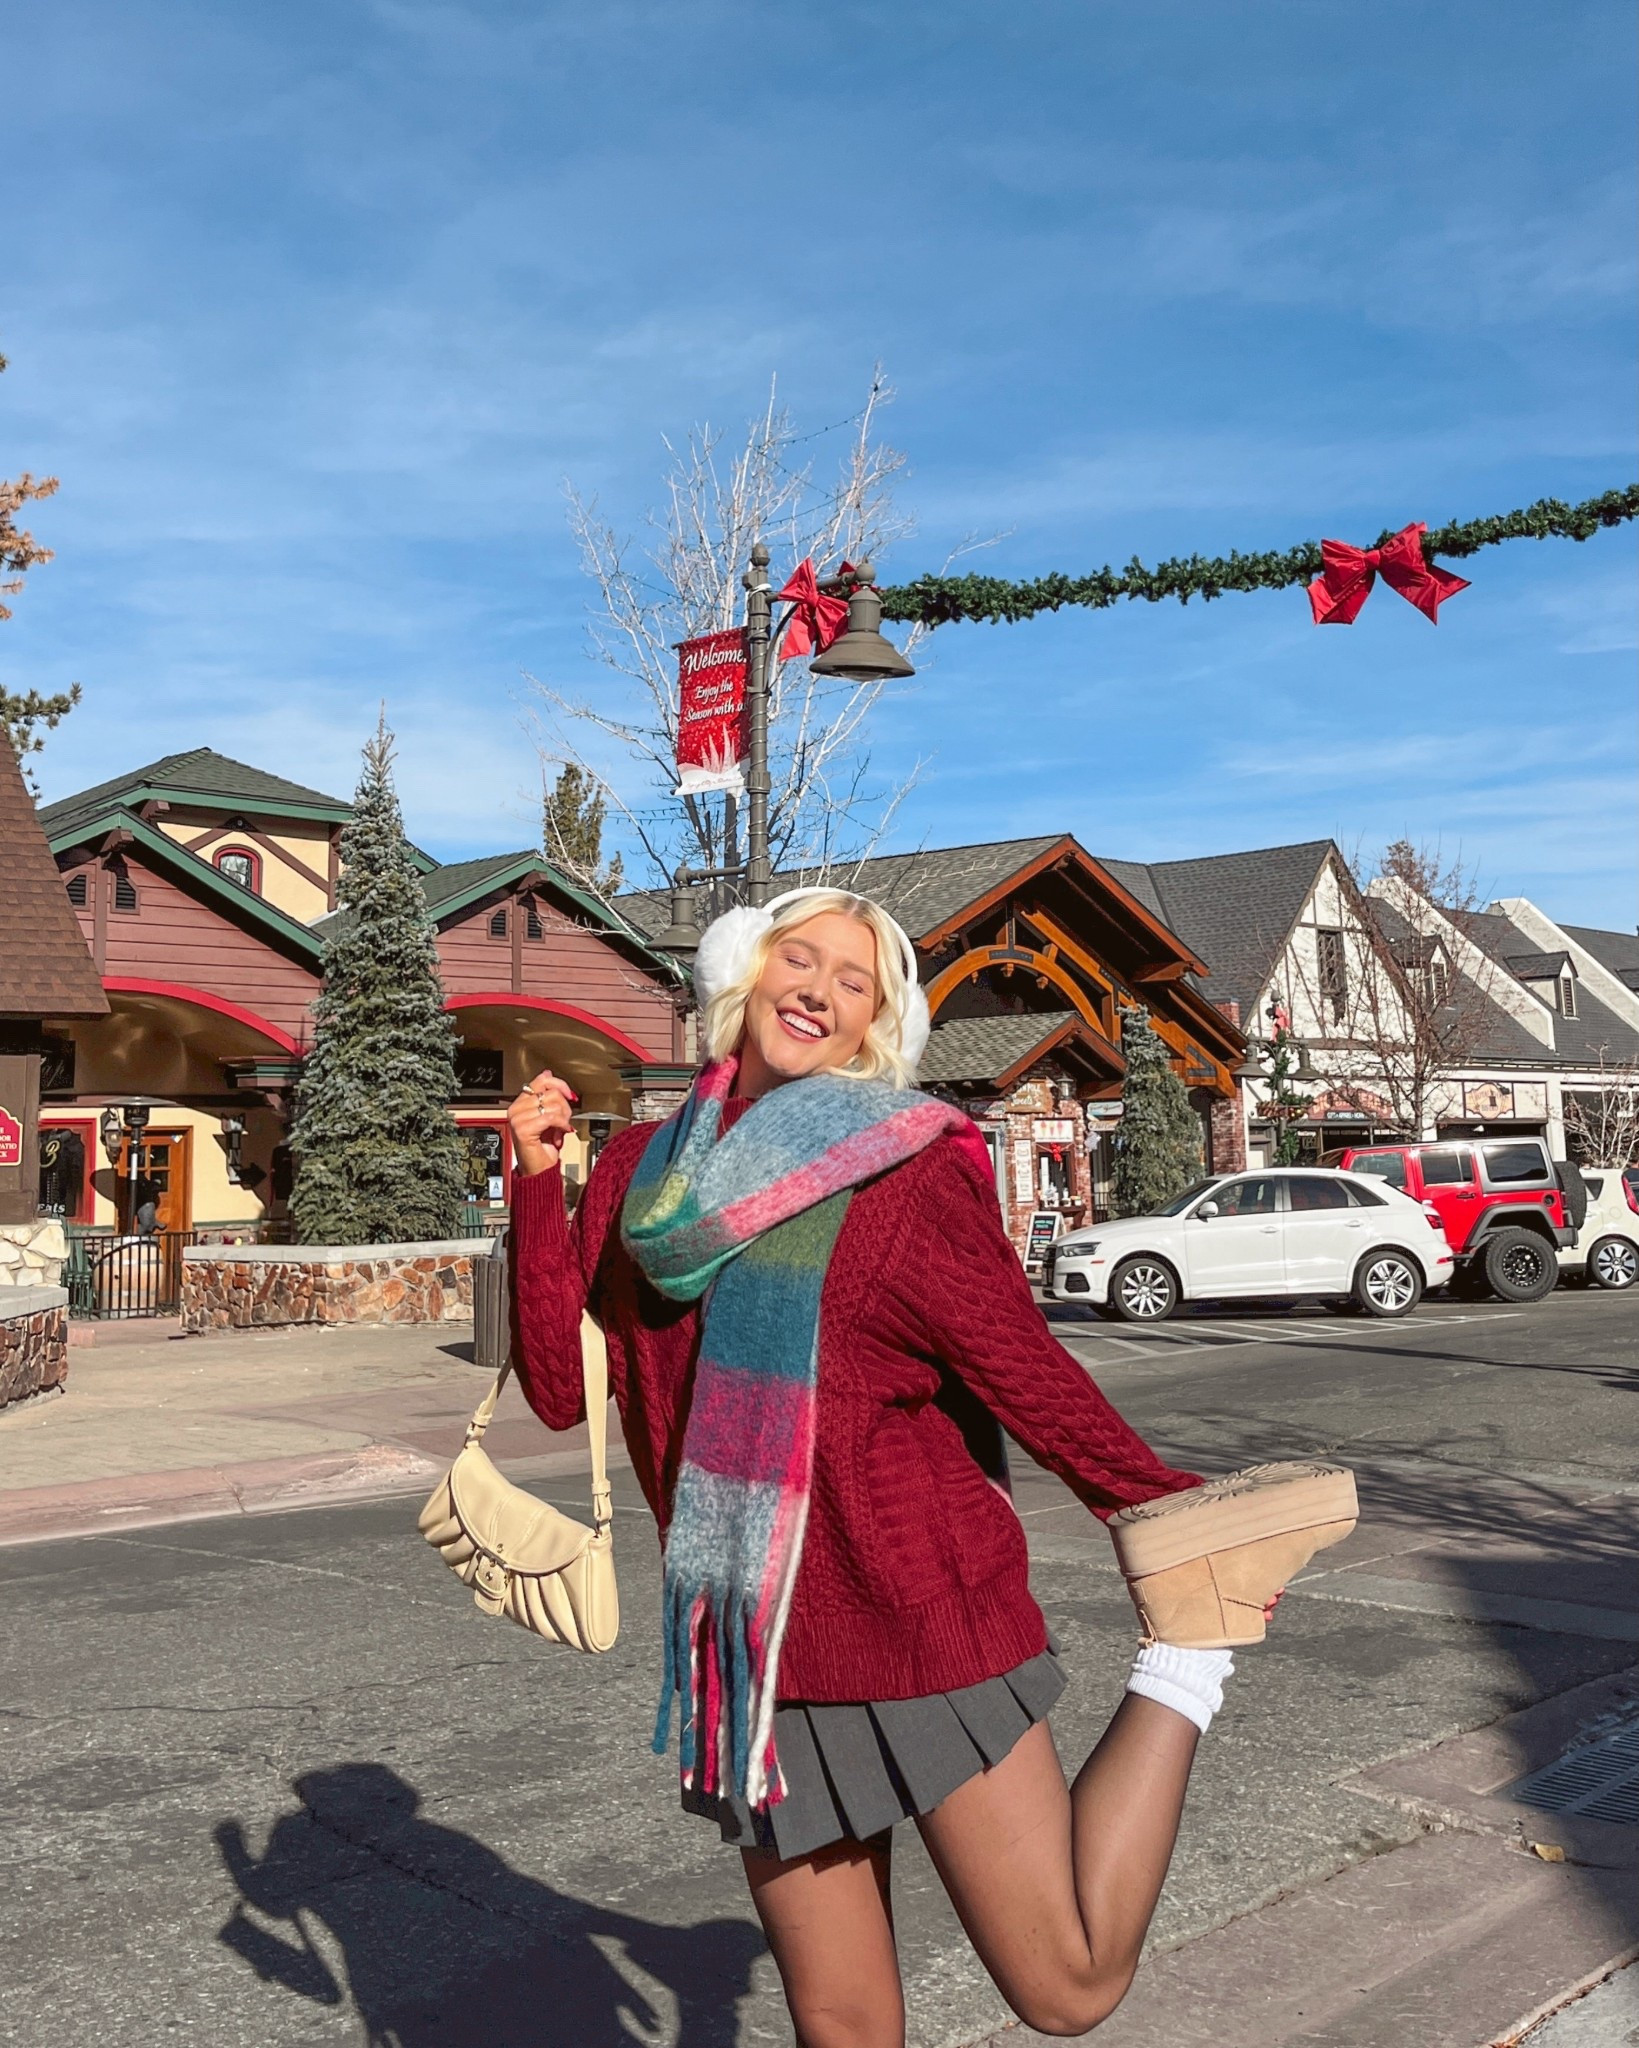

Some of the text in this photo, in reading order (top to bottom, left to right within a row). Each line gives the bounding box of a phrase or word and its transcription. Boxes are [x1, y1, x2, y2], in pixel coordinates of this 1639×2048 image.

[694, 676, 733, 704] Enjoy the
[684, 707, 712, 722] Season
[713, 695, 734, 715] with
